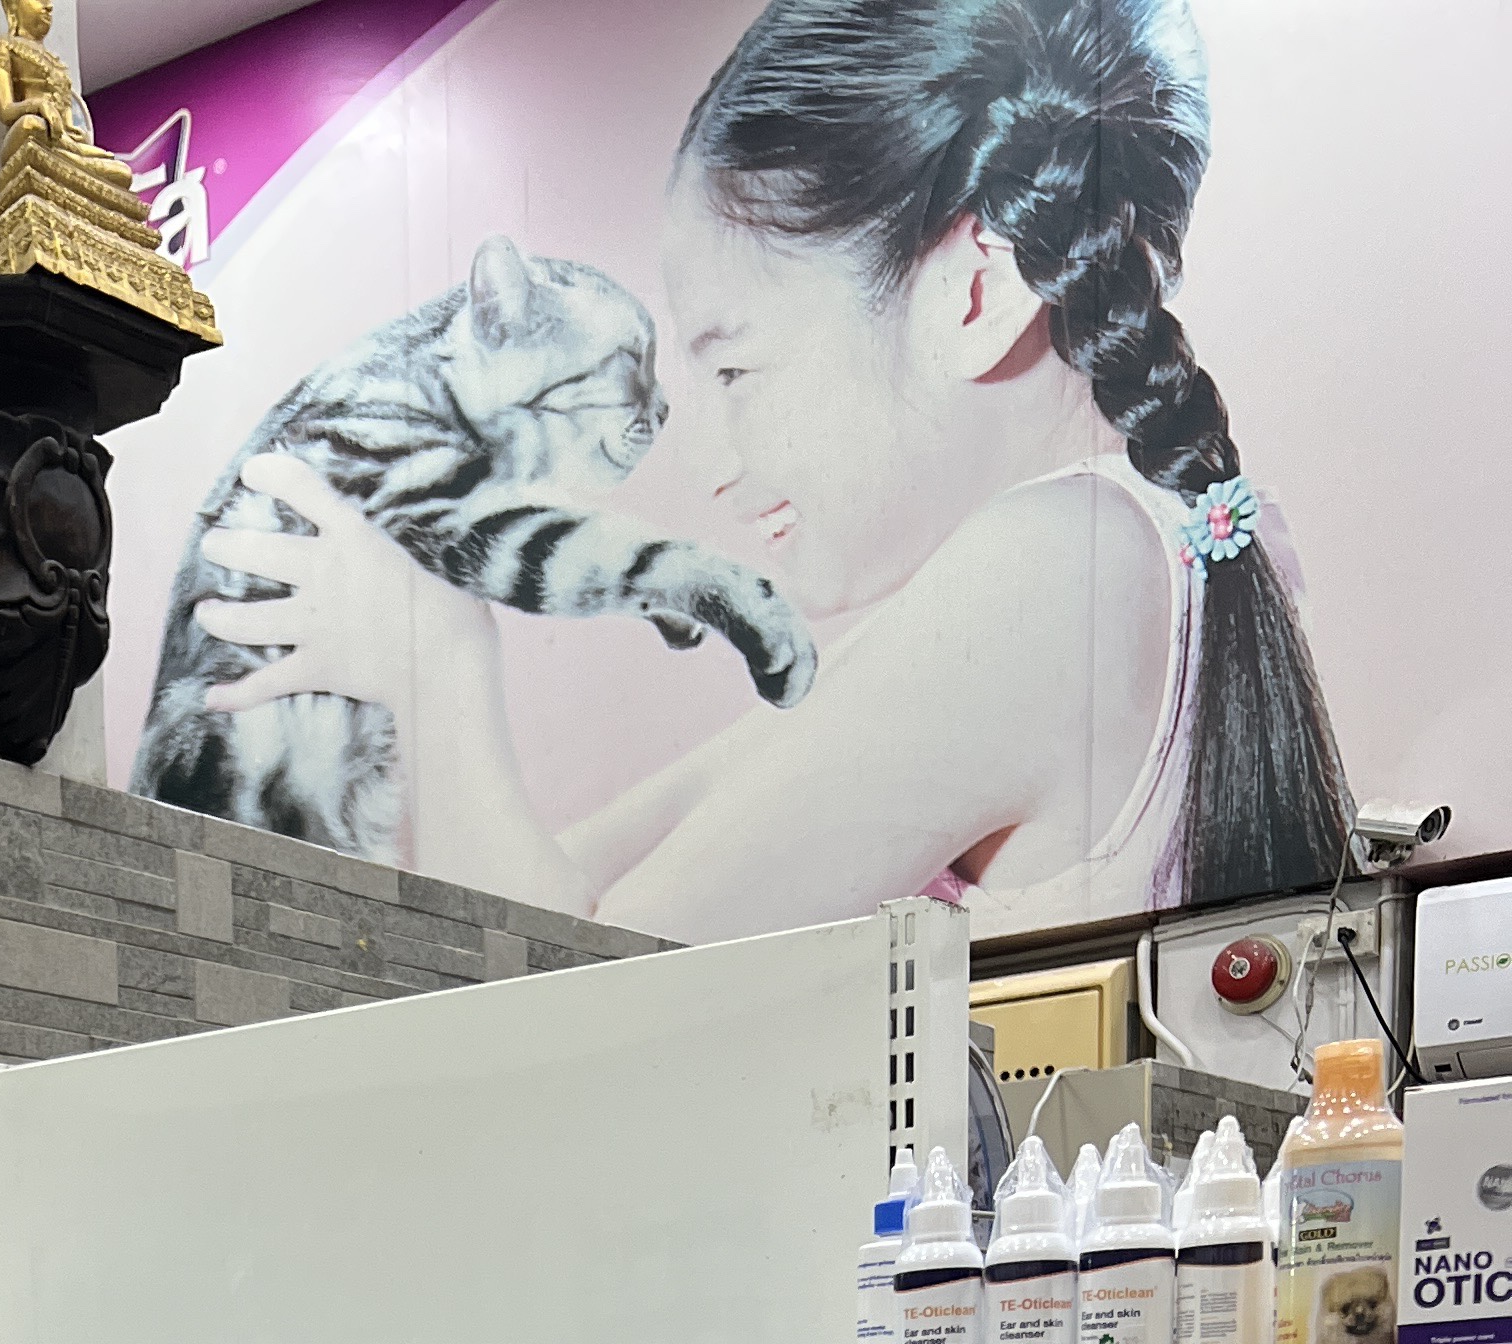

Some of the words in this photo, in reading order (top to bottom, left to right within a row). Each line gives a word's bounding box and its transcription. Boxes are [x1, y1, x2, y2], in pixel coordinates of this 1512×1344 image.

[1300, 1228, 1334, 1240] GOLD
[1414, 1250, 1493, 1276] NANO
[1414, 1271, 1512, 1309] OTIC
[1095, 1310, 1114, 1319] and
[1117, 1308, 1141, 1318] skin
[1000, 1321, 1014, 1331] Ear
[1020, 1319, 1041, 1329] and
[1043, 1318, 1063, 1328] skin
[904, 1328, 918, 1338] Ear
[921, 1326, 942, 1336] and
[945, 1325, 966, 1335] skin
[1000, 1329, 1045, 1341] cleanser
